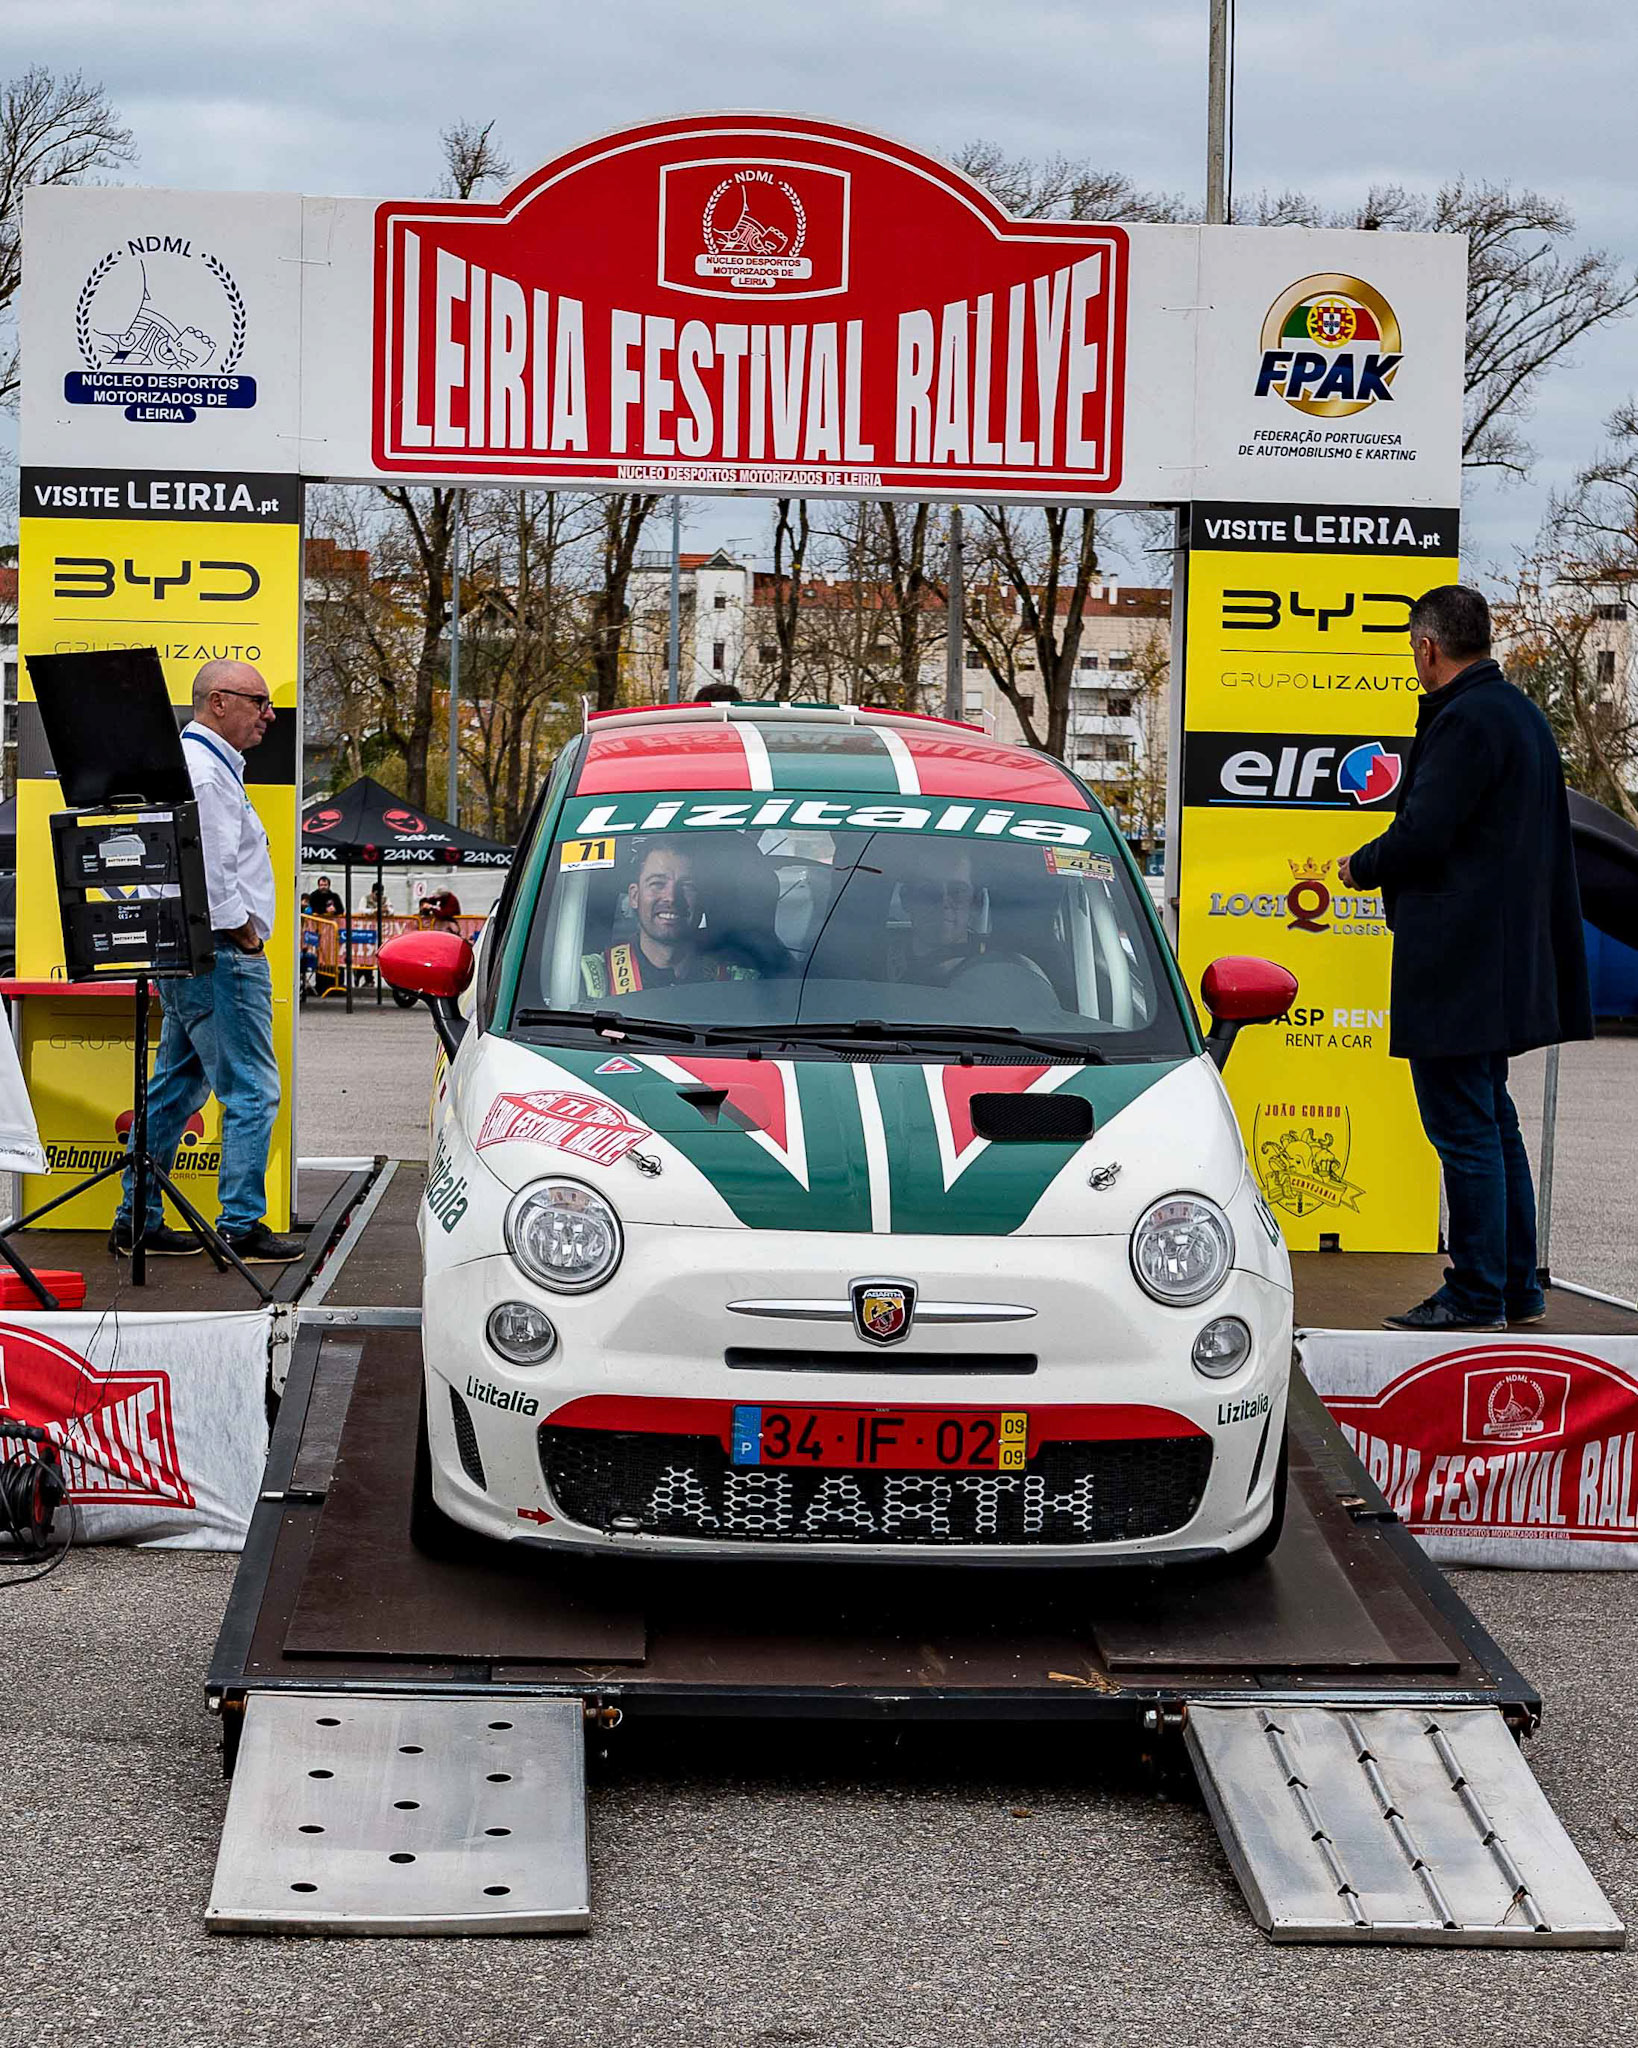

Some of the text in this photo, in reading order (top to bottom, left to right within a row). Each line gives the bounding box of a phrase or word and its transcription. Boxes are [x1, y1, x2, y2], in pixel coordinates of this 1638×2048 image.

[734, 170, 774, 185] NDML
[128, 235, 192, 258] NDML
[713, 267, 779, 276] MOTORIZADOS
[746, 258, 801, 267] DESPORTOS
[739, 278, 768, 286] LEIRIA
[401, 228, 1101, 470] LEIRIA FESTIVAL RALLYE
[81, 372, 239, 390] NÚCLEO DESPORTOS
[1254, 351, 1405, 401] FPAK
[93, 391, 227, 405] MOTORIZADOS DE
[137, 408, 184, 420] LEIRIA
[1253, 429, 1402, 445] FEDERAÇÃO PORTUGUESA
[1238, 445, 1416, 462] DE AUTOMOBILISMO E KARTING
[618, 466, 882, 486] NUCLEO DESPORTOS MOTORIZADOS DE LEIRIA
[34, 485, 120, 508] VISITE
[1204, 518, 1287, 542] VISITE
[54, 557, 260, 601] BYD
[1221, 589, 1416, 633] BYD
[1219, 747, 1337, 798] elf
[576, 798, 1092, 846] Lizitalia
[300, 846, 514, 866] 4MX 24MX 24MX
[579, 841, 606, 861] 71
[1070, 861, 1112, 873] 415
[1285, 1034, 1372, 1048] RENT A CAR
[558, 1100, 589, 1116] 71
[1265, 1102, 1341, 1118] JOÃO GORDO
[510, 1110, 581, 1145] FESTIVAL
[564, 1125, 641, 1163] RALLYE
[466, 1375, 539, 1417] Lizitalia
[1218, 1393, 1269, 1426] Lizitalia
[1004, 1419, 1025, 1434] 09
[741, 1442, 752, 1455] P
[1003, 1450, 1024, 1465] 09
[1423, 1449, 1568, 1524] FESTIVAL
[647, 1466, 1093, 1535] ABARTH
